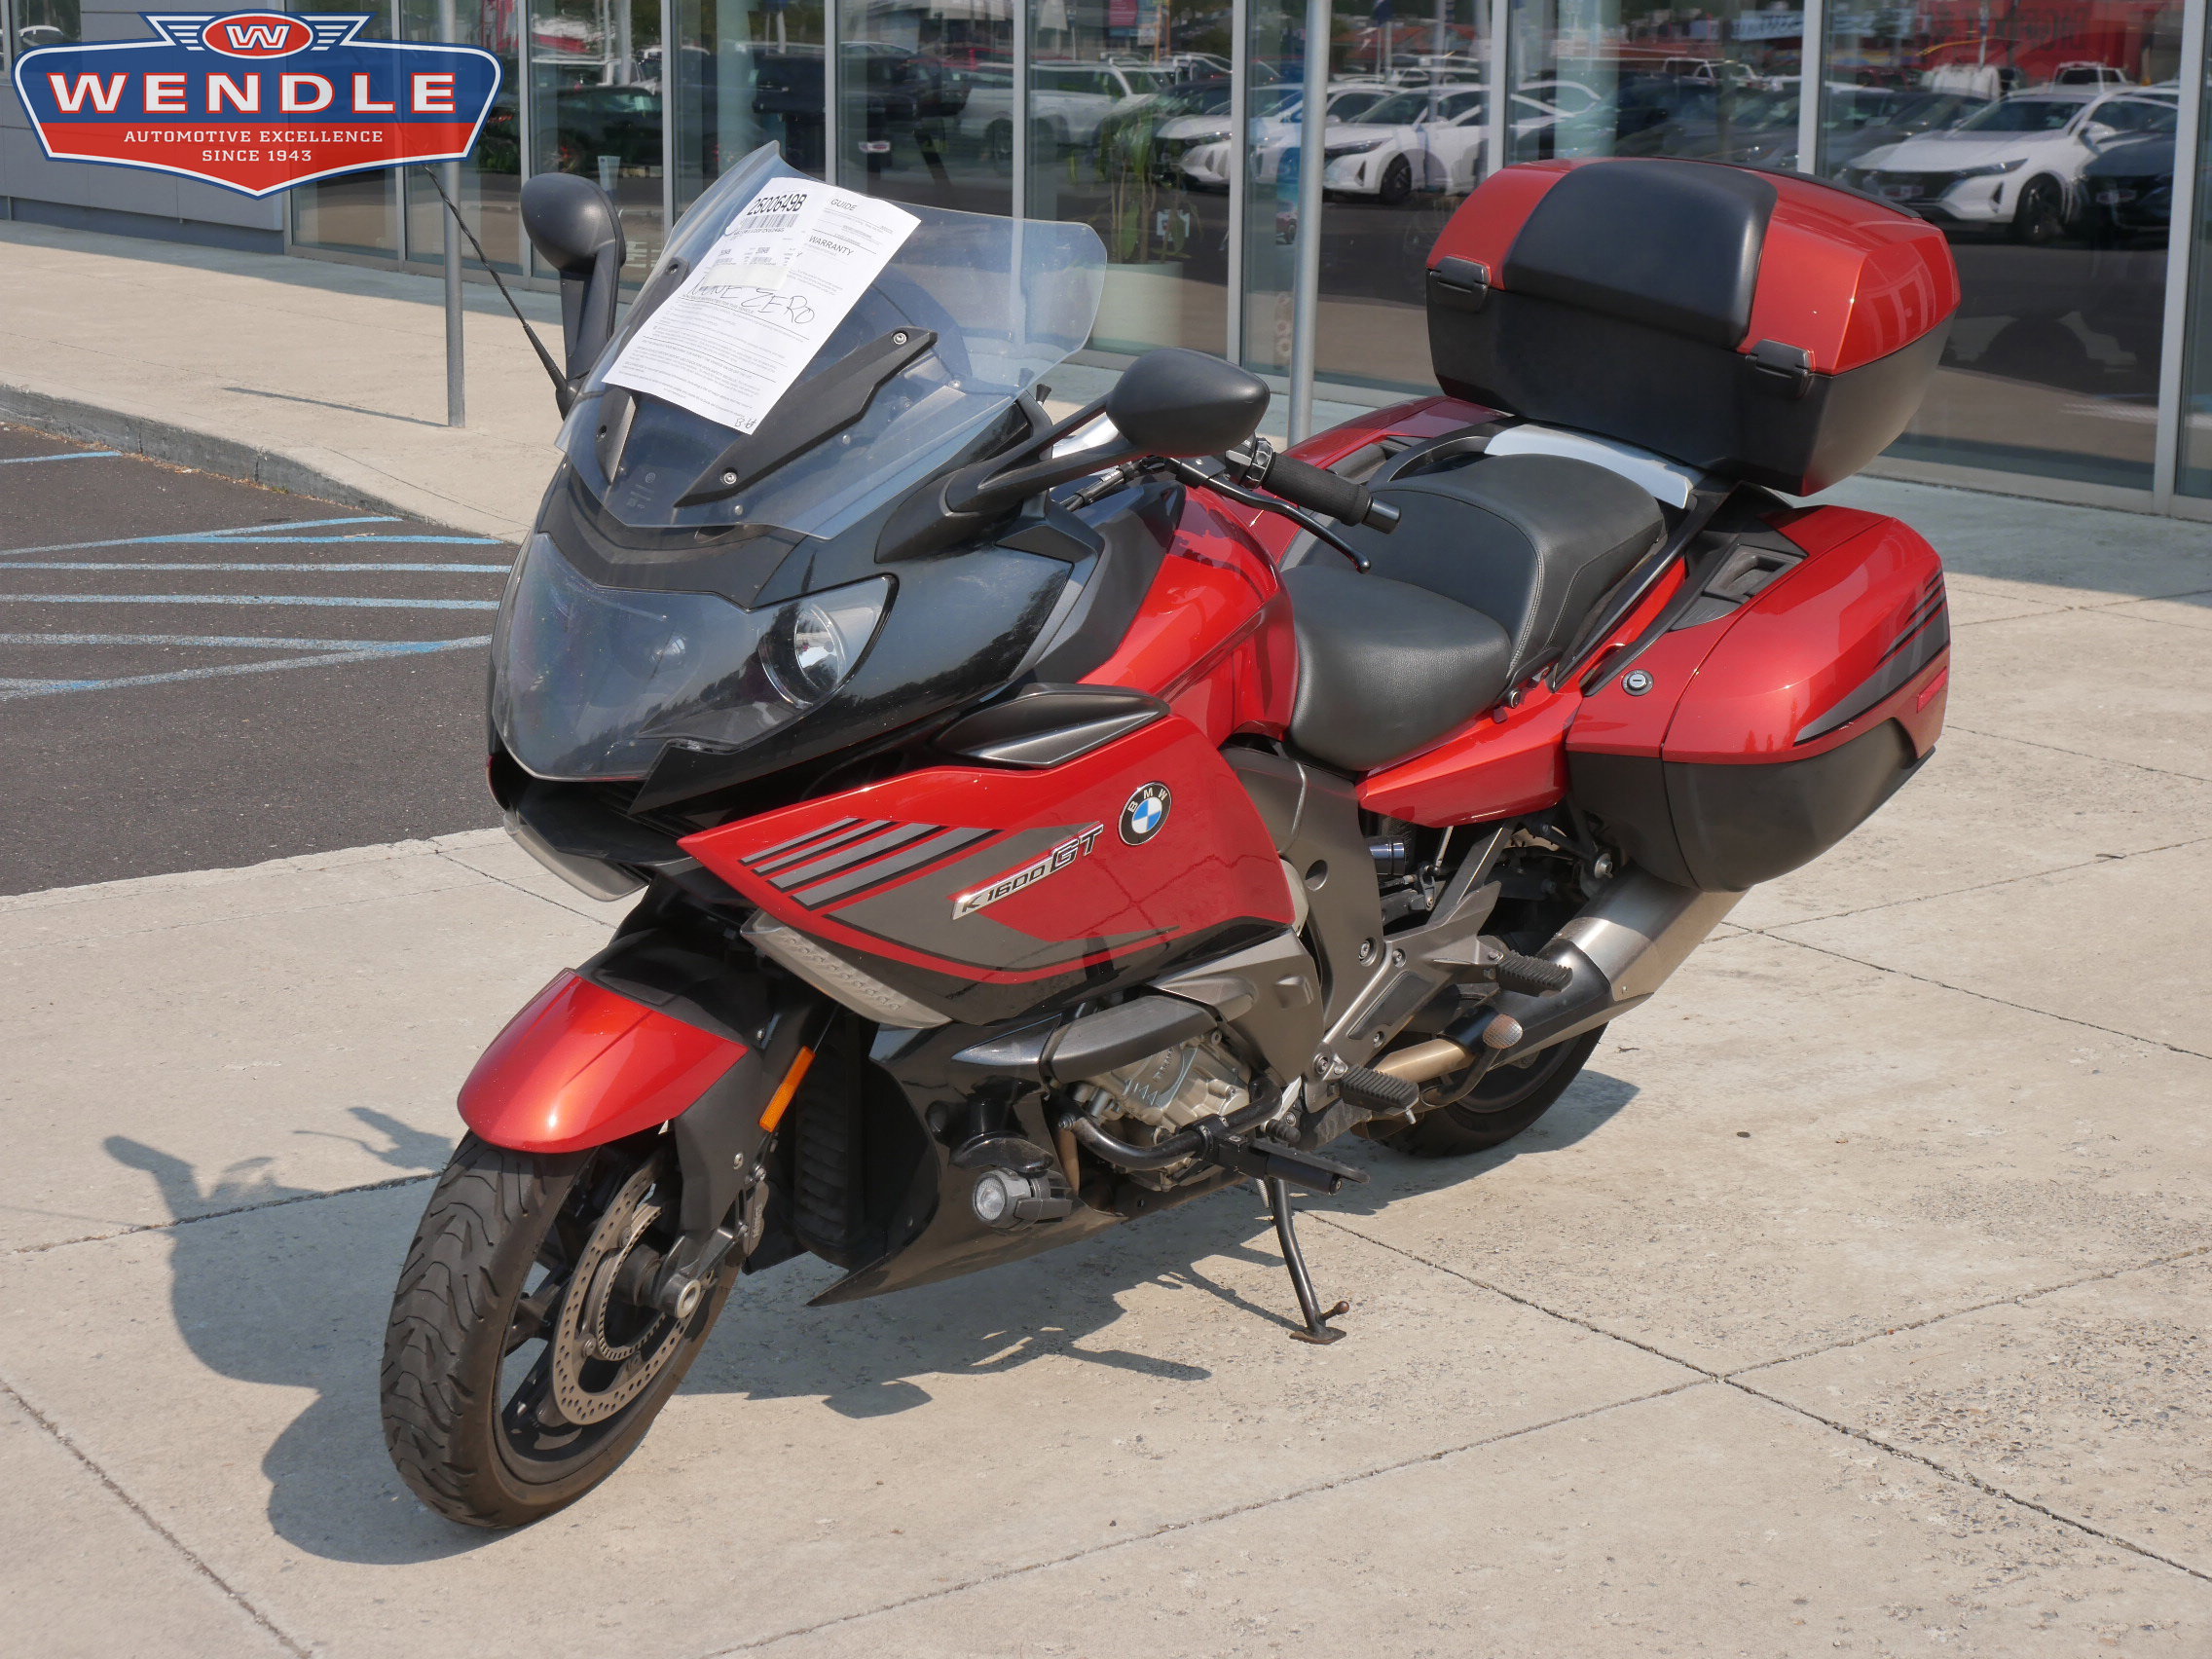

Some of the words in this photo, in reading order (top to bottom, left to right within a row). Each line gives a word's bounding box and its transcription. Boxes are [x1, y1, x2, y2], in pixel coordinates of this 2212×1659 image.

[830, 199, 857, 211] GUIDE
[808, 235, 854, 256] WARRANTY
[1126, 787, 1167, 813] BMW
